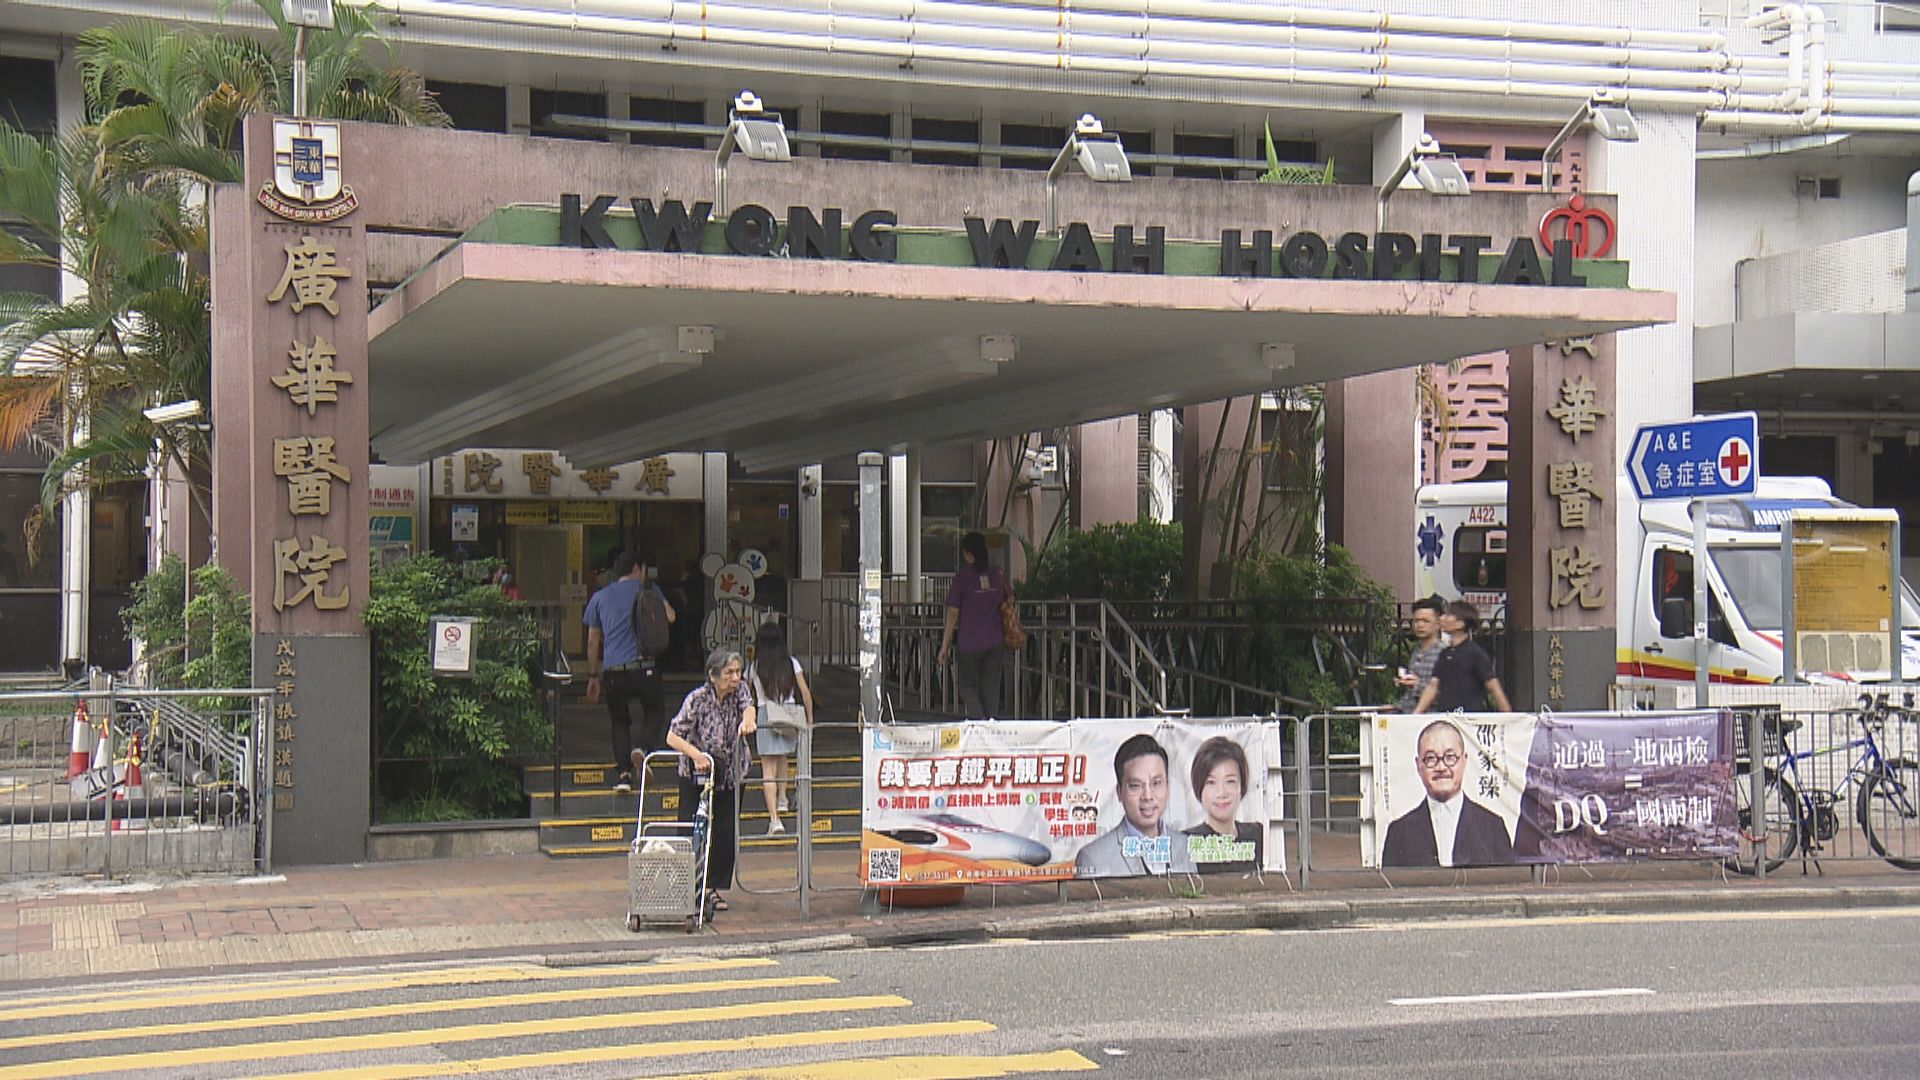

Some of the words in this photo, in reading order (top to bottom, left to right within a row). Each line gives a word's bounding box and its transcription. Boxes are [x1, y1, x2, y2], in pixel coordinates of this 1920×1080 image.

[560, 194, 898, 263] KWONG
[963, 217, 1165, 275] WAH
[1221, 229, 1587, 288] HOSPITAL
[267, 236, 353, 612] 廣華醫院
[1655, 459, 1717, 489] 急症室
[1469, 506, 1495, 523] A422
[1553, 736, 1709, 769] 通過一地兩檢
